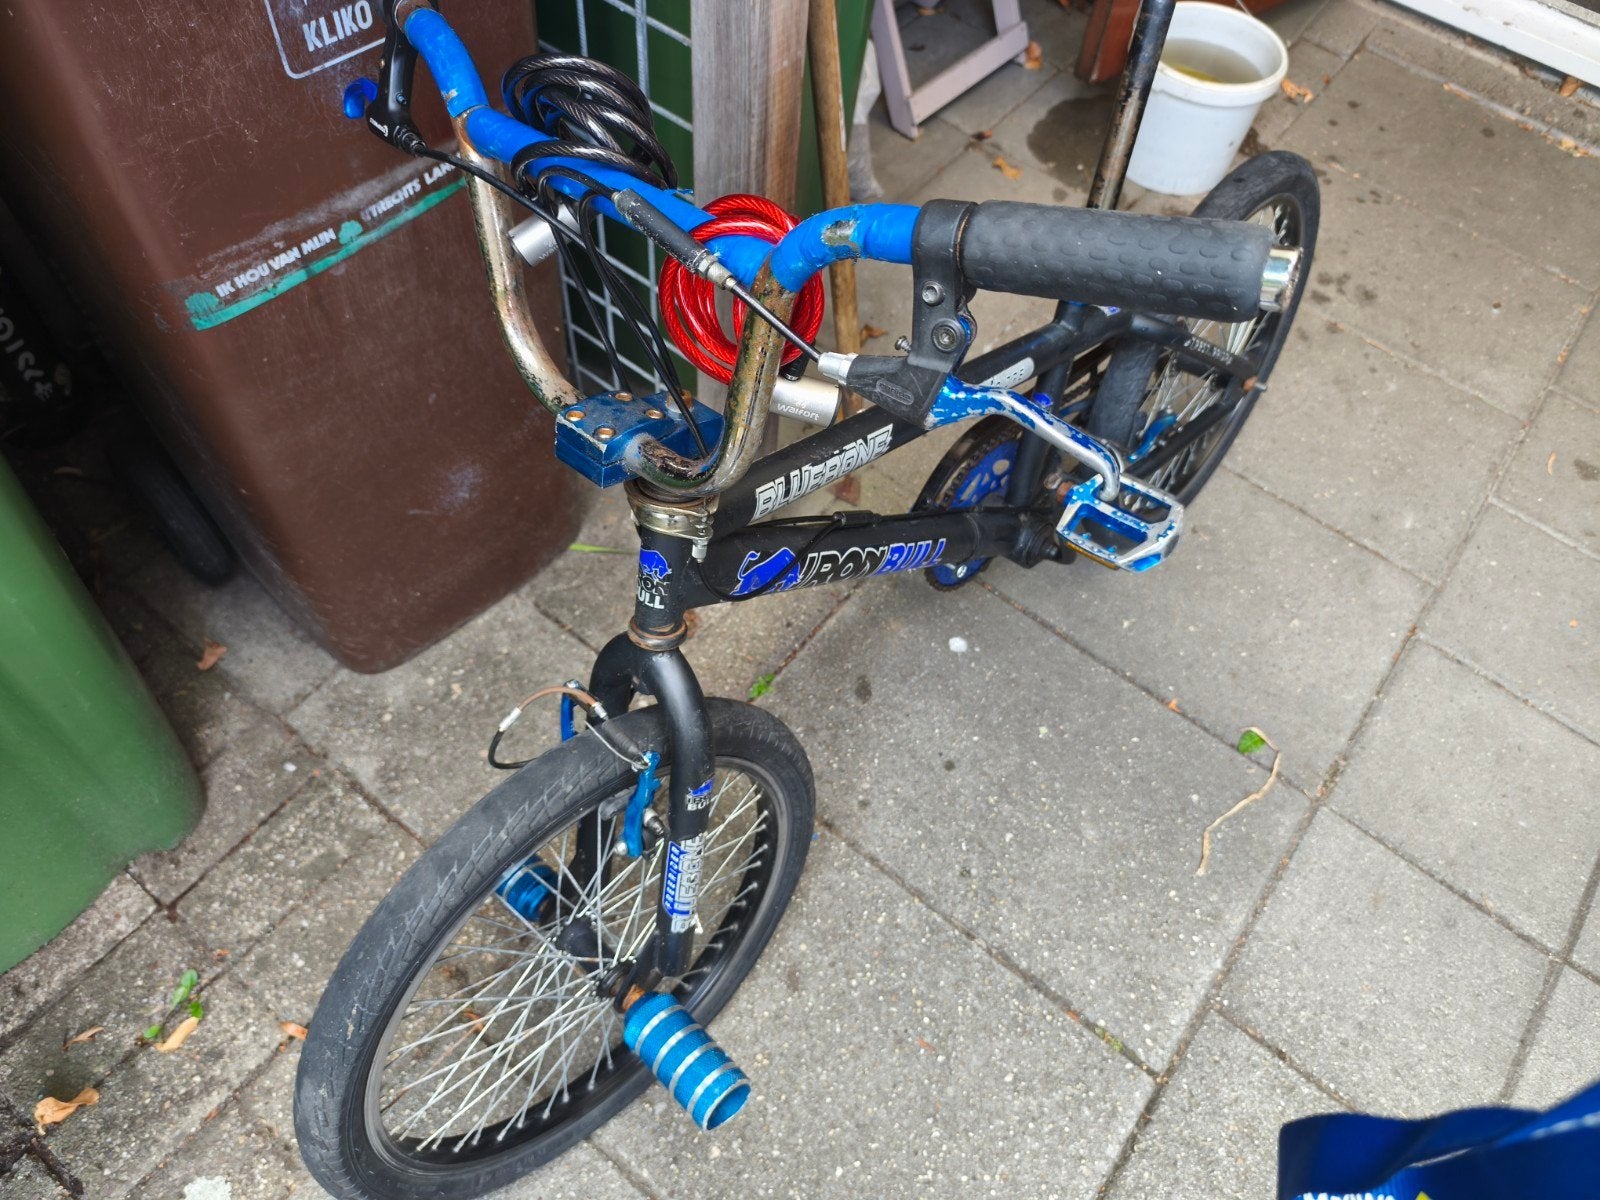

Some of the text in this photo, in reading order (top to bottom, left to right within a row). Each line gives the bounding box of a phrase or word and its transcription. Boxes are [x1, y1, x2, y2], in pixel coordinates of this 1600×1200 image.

[302, 0, 373, 52] KLIKO
[215, 280, 236, 297] IK
[233, 262, 270, 289] HOU
[268, 246, 301, 271] VAN
[300, 227, 337, 255] MIJN
[753, 423, 894, 521] BLUEBONE
[637, 586, 665, 610] ULL
[664, 844, 682, 910] FREERIDER
